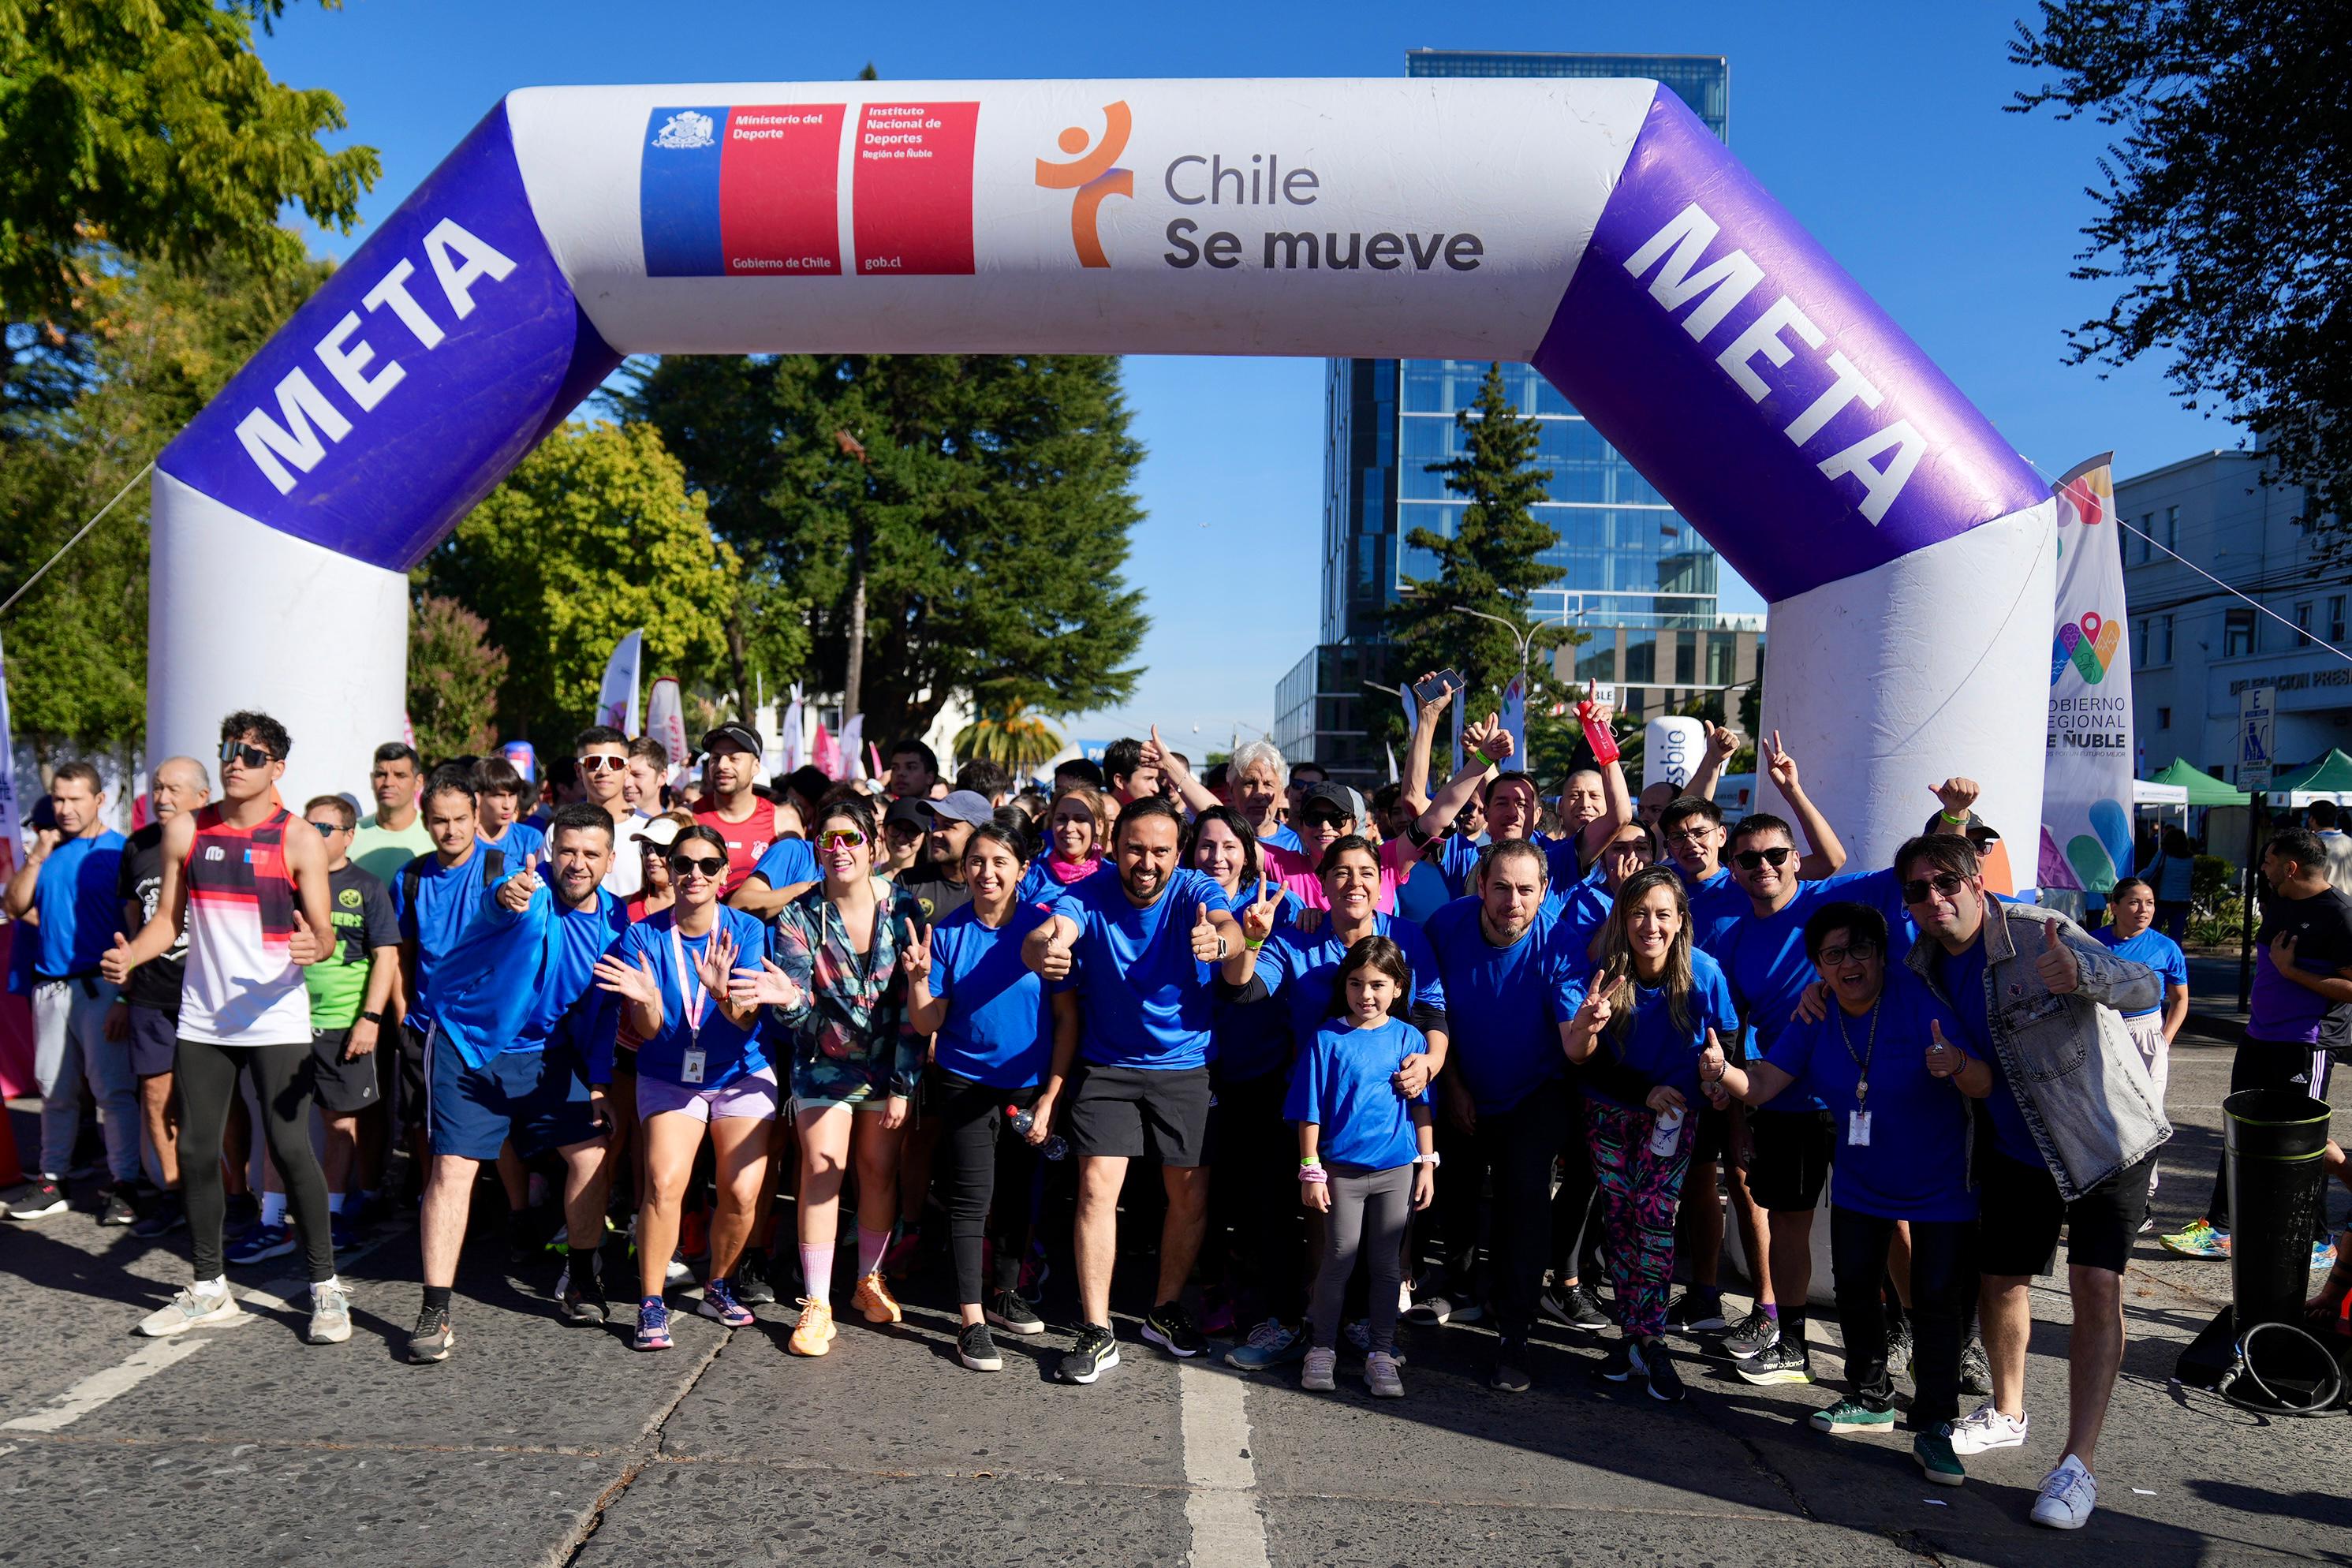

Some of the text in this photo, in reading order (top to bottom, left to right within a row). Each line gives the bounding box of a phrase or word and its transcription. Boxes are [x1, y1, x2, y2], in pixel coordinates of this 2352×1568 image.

[868, 106, 924, 116] Instituto
[735, 114, 823, 125] Ministerio del
[866, 119, 941, 129] Nacional de
[733, 129, 784, 141] Deporte
[864, 133, 923, 145] Deportes
[862, 148, 932, 160] Región de Ñuble
[1164, 154, 1320, 206] Chile
[1164, 218, 1484, 271] Se mueve
[733, 257, 831, 268] Gobierno de Chile
[864, 257, 902, 270] gob.cl
[234, 217, 518, 496] META
[1622, 201, 1928, 528] META
[2253, 690, 2261, 709] E
[2063, 730, 2126, 748] ÑUBLE
